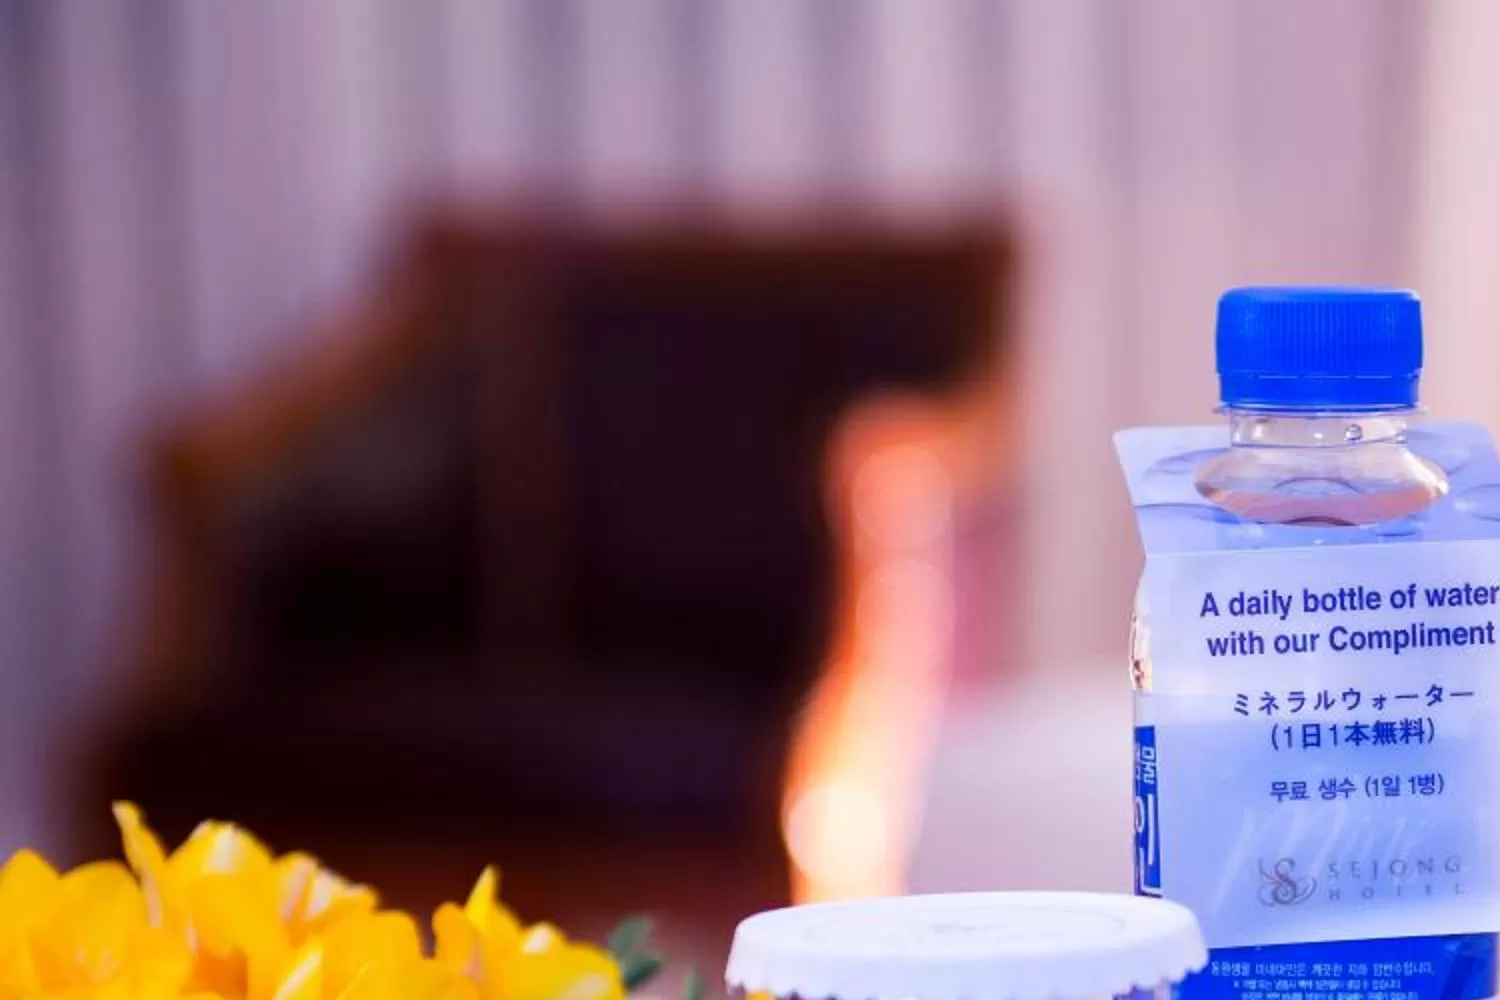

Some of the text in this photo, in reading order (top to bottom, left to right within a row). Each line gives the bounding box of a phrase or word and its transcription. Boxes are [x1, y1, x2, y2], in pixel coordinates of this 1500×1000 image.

[1200, 582, 1500, 621] A daily bottle of water
[1207, 620, 1497, 657] with our Compliment
[1234, 684, 1475, 716] ミネラルウォーター
[1270, 773, 1446, 803] 무료 생수 (1일 1병)
[1328, 855, 1462, 880] SEJONG
[1329, 883, 1465, 901] HOTEL
